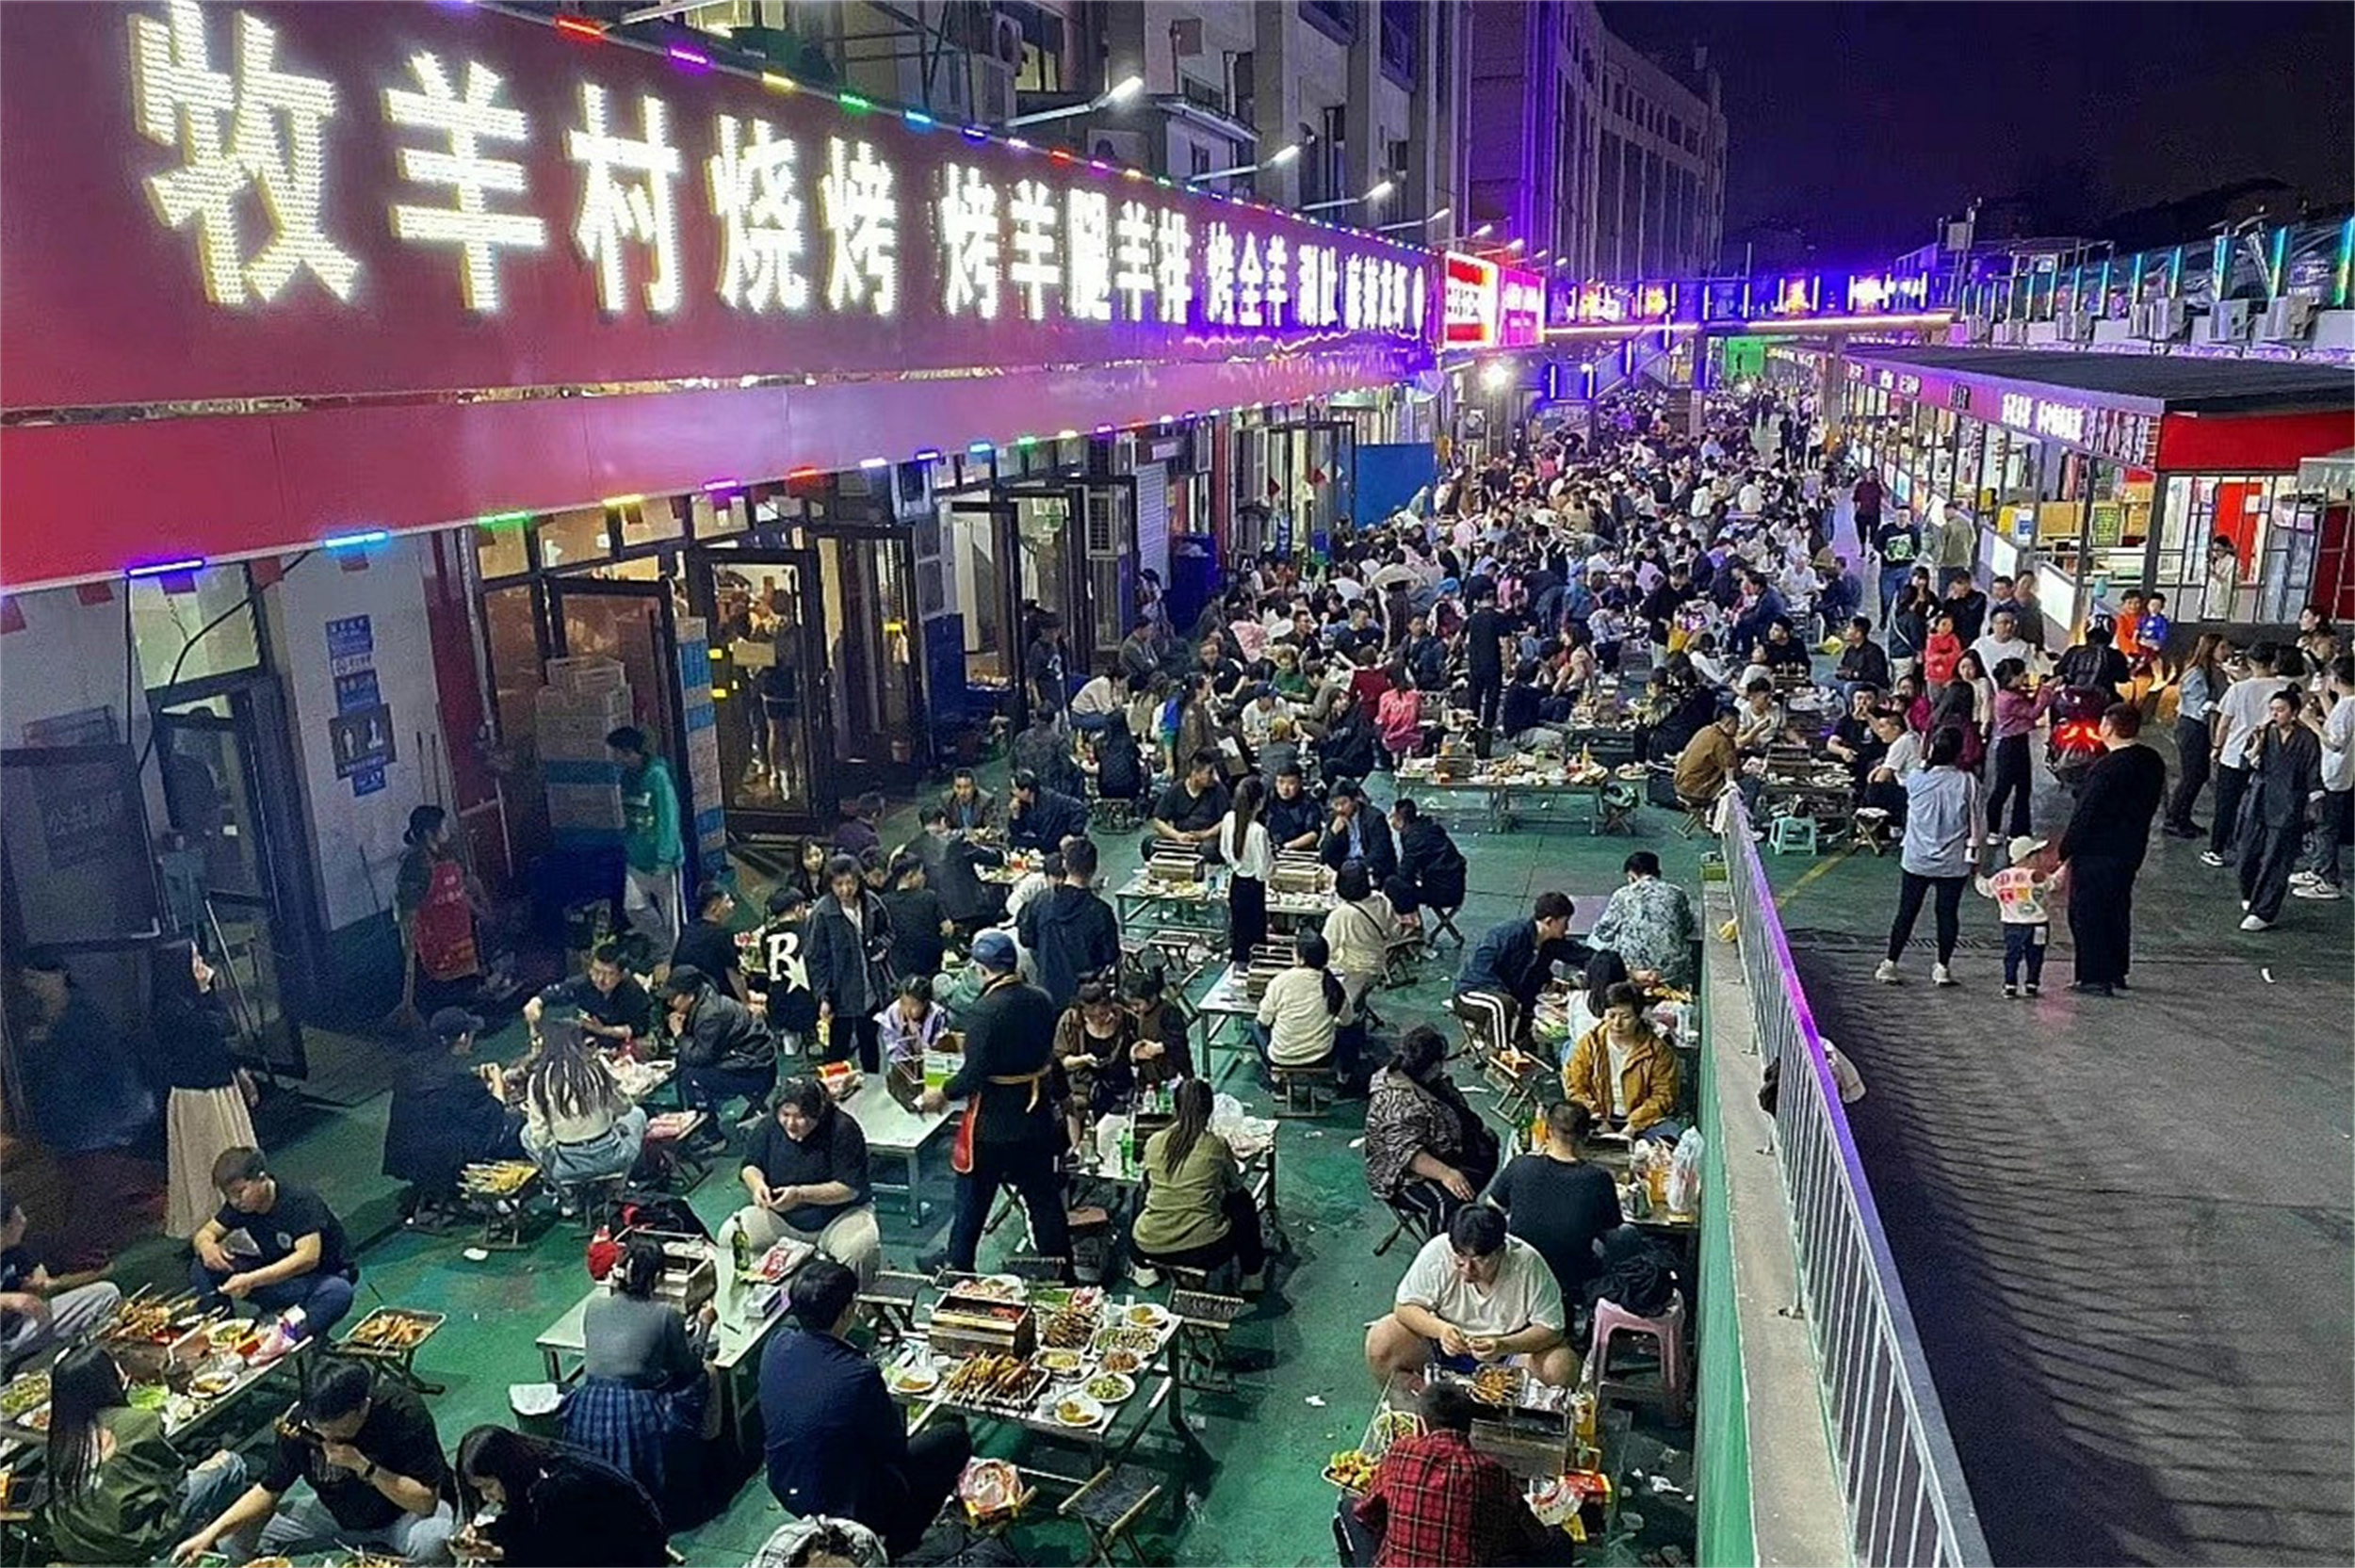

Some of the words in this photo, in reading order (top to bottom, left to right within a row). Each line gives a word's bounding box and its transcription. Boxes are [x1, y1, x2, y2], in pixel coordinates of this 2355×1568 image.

[130, 2, 899, 316] 牧羊村烧烤
[940, 161, 1192, 323] 烤羊腿羊排
[1207, 221, 1288, 327] 烤全羊
